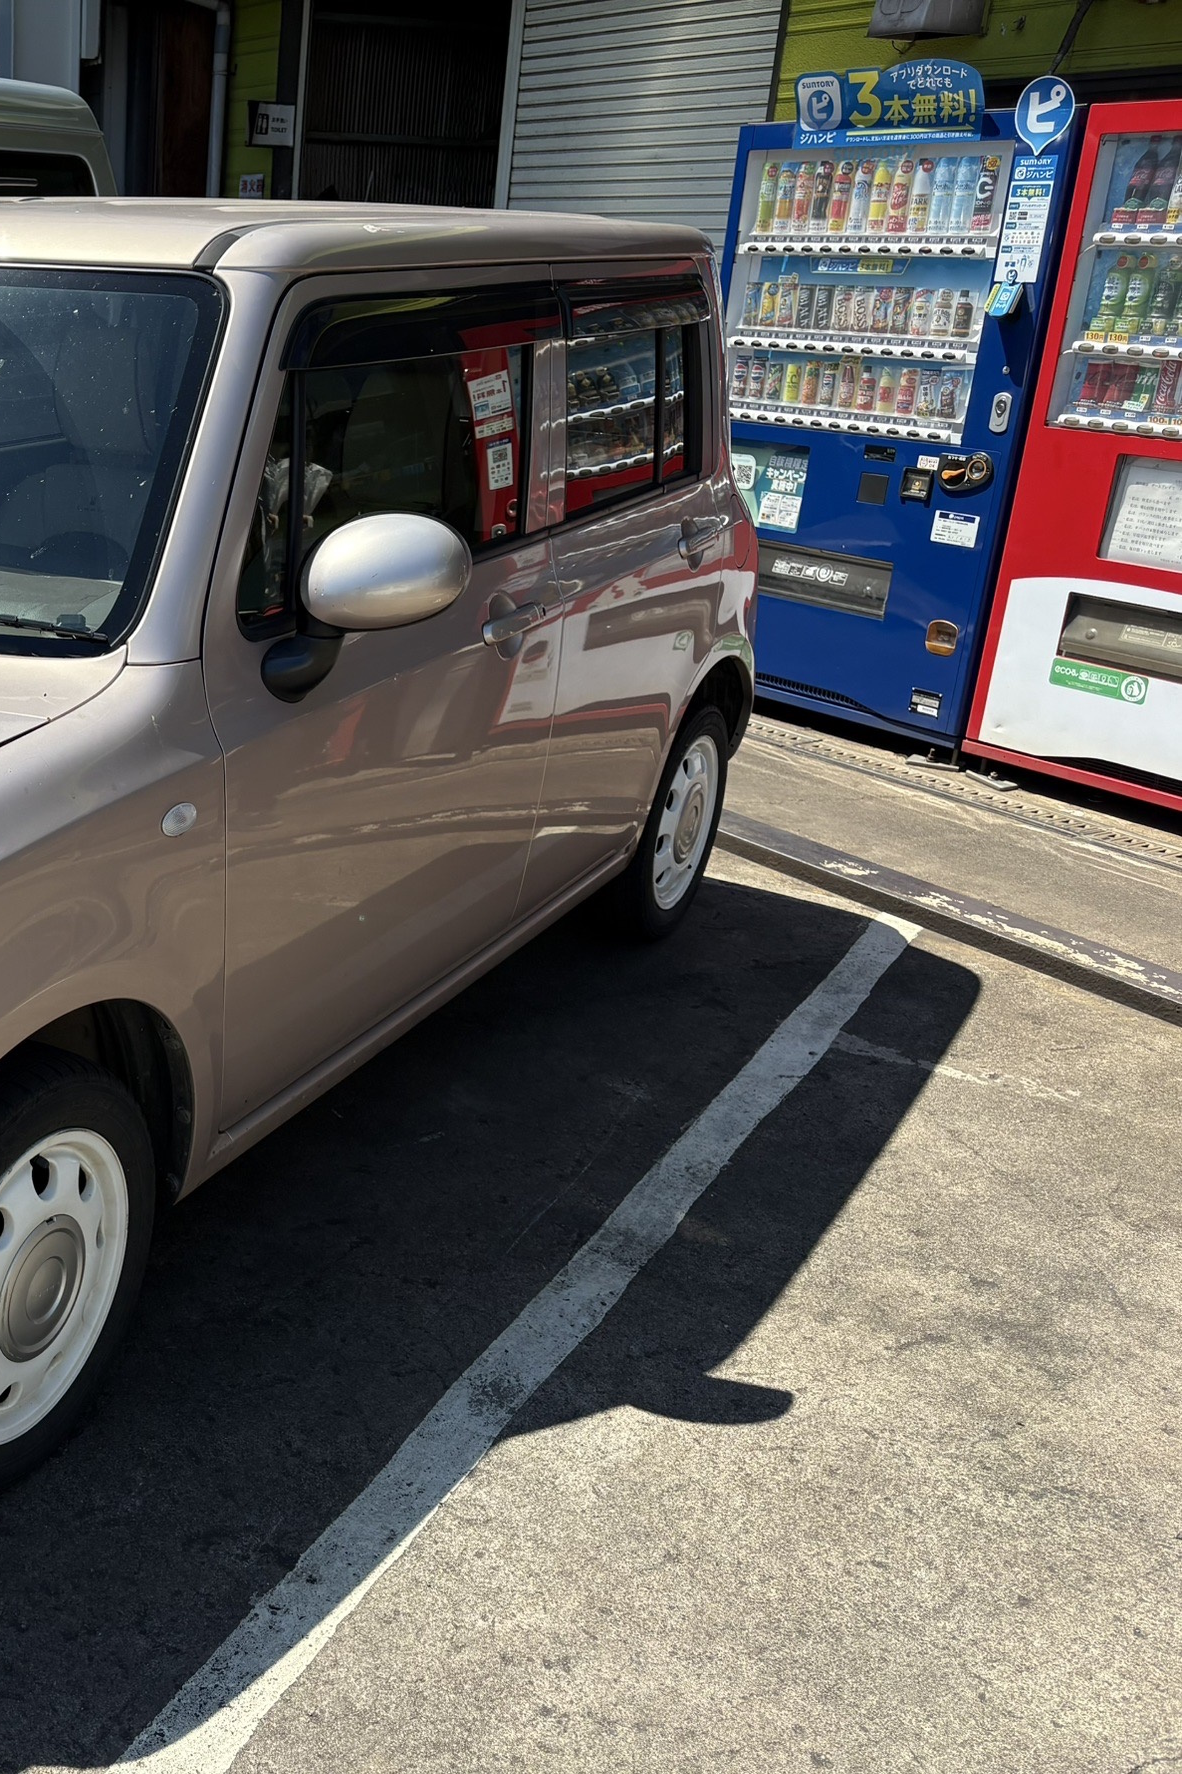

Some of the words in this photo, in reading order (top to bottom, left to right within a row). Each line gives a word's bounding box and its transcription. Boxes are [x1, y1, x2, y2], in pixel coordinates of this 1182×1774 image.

[890, 64, 968, 82] アプリダウンロード
[801, 80, 835, 90] SUNTORY
[907, 77, 953, 90] でどれでも
[1026, 84, 1066, 133] ピ
[800, 132, 837, 145] ジハンピ
[1026, 170, 1054, 179] ジハンピ
[857, 297, 867, 328] BOSS
[1085, 332, 1103, 340] 130円
[1109, 333, 1127, 341] 130円
[765, 466, 807, 483] キャンペーン
